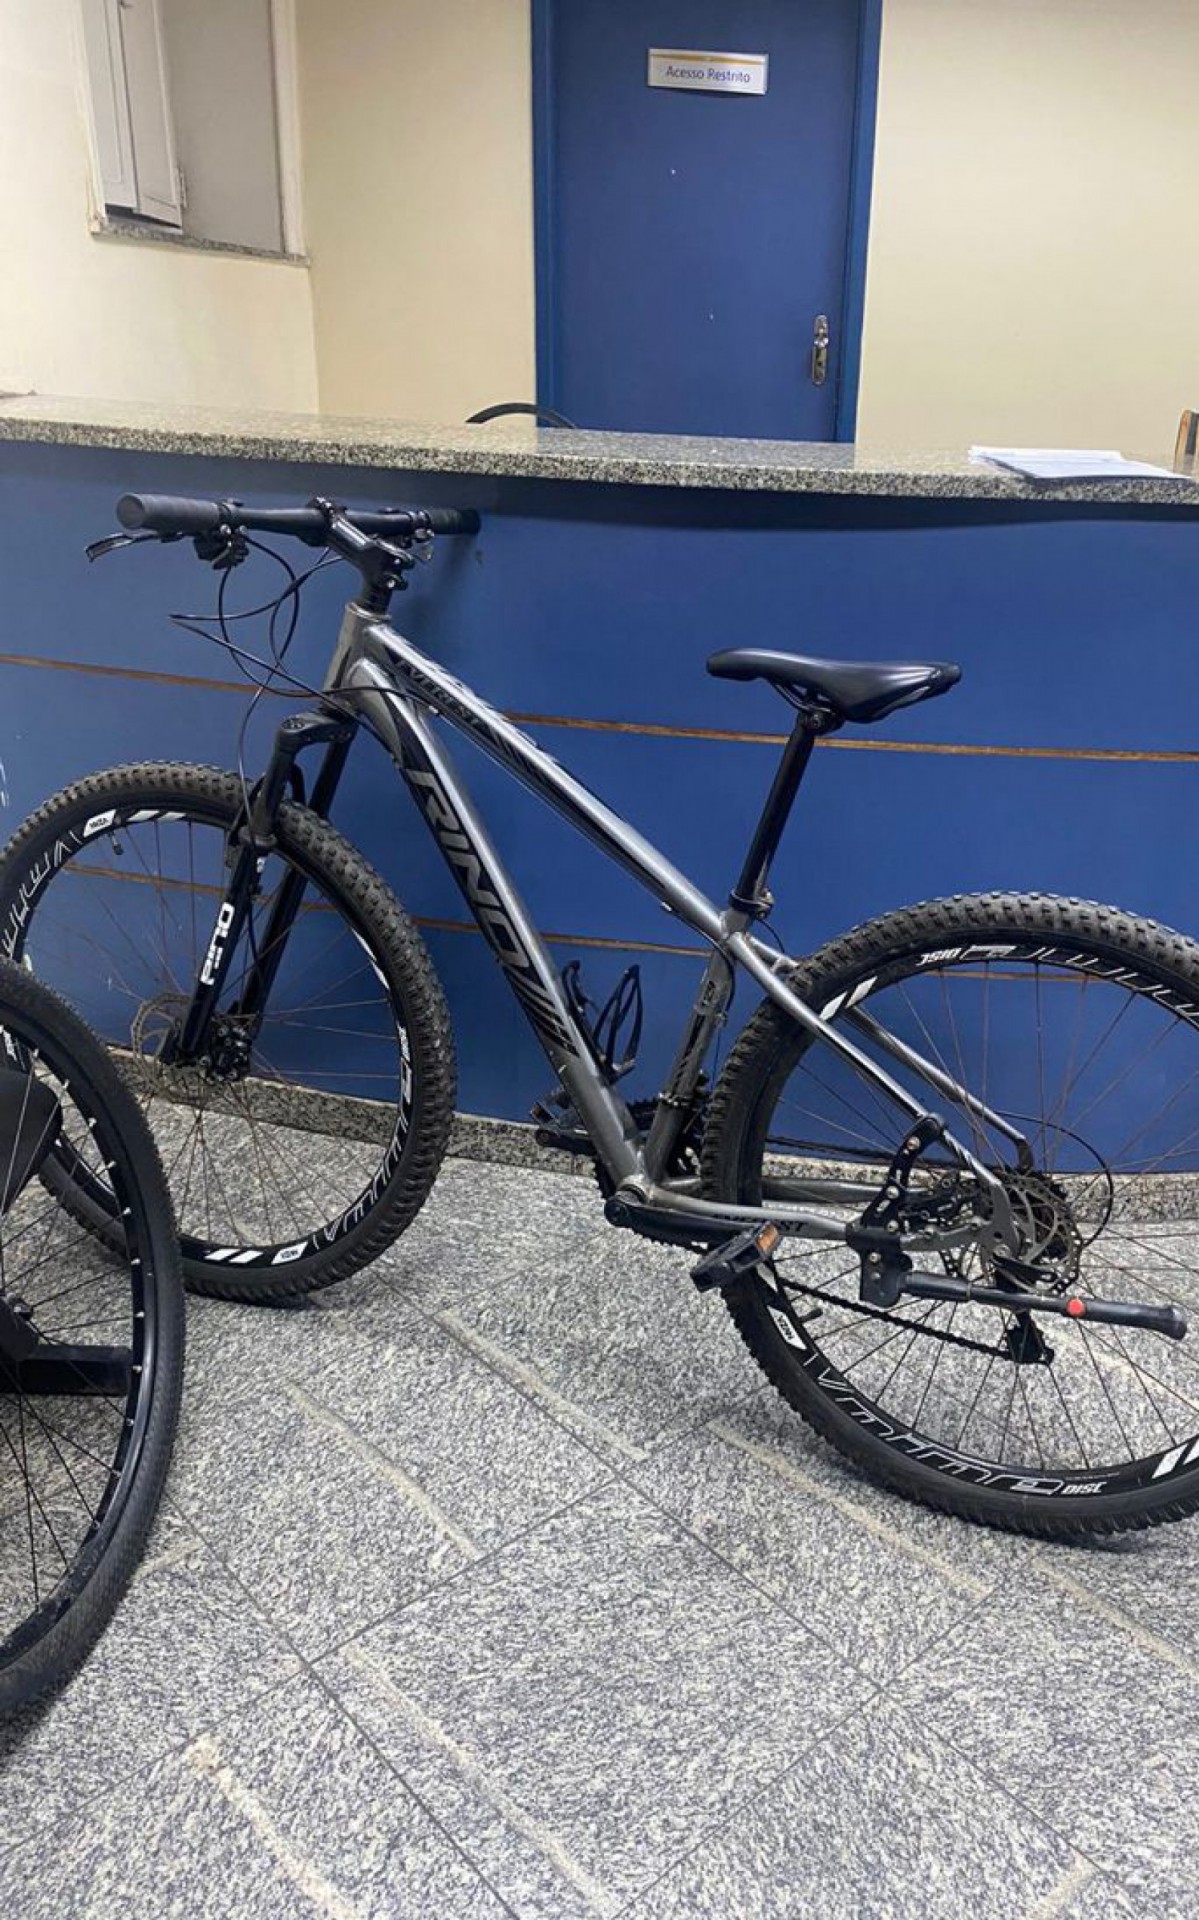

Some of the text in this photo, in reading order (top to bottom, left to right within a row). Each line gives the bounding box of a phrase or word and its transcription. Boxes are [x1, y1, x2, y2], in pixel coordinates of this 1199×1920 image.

[666, 66, 751, 82] Acesso Restrito
[405, 768, 529, 967] RINO
[1061, 1481, 1107, 1494] DISC
